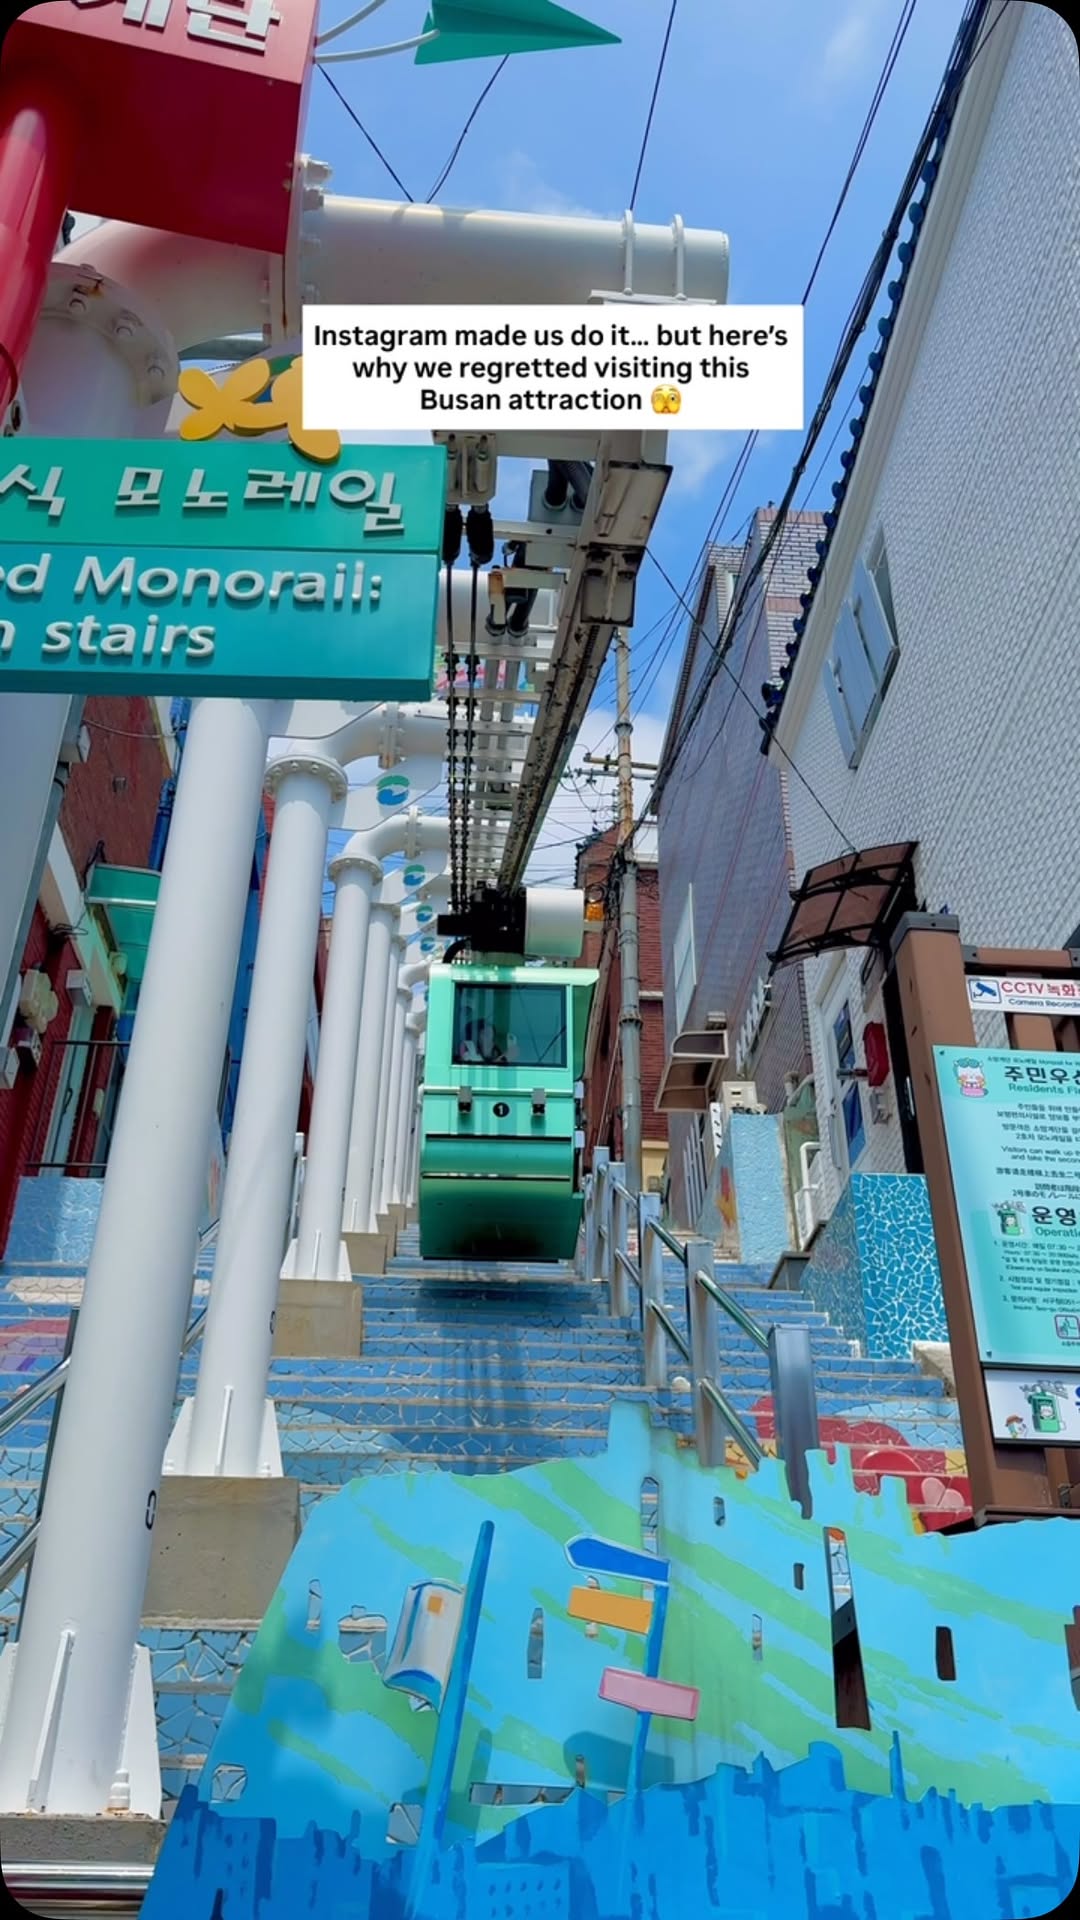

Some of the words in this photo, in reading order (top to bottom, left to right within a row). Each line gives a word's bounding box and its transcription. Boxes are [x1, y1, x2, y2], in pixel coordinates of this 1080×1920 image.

[0, 464, 66, 518] 식
[114, 465, 406, 533] 모노레일
[0, 553, 53, 597] d
[73, 556, 383, 603] Monorail:
[41, 613, 216, 658] stairs
[1001, 981, 1044, 994] CCTV
[1008, 998, 1044, 1007] Camera
[1008, 1083, 1065, 1095] Residents
[1031, 1205, 1077, 1227] 운영
